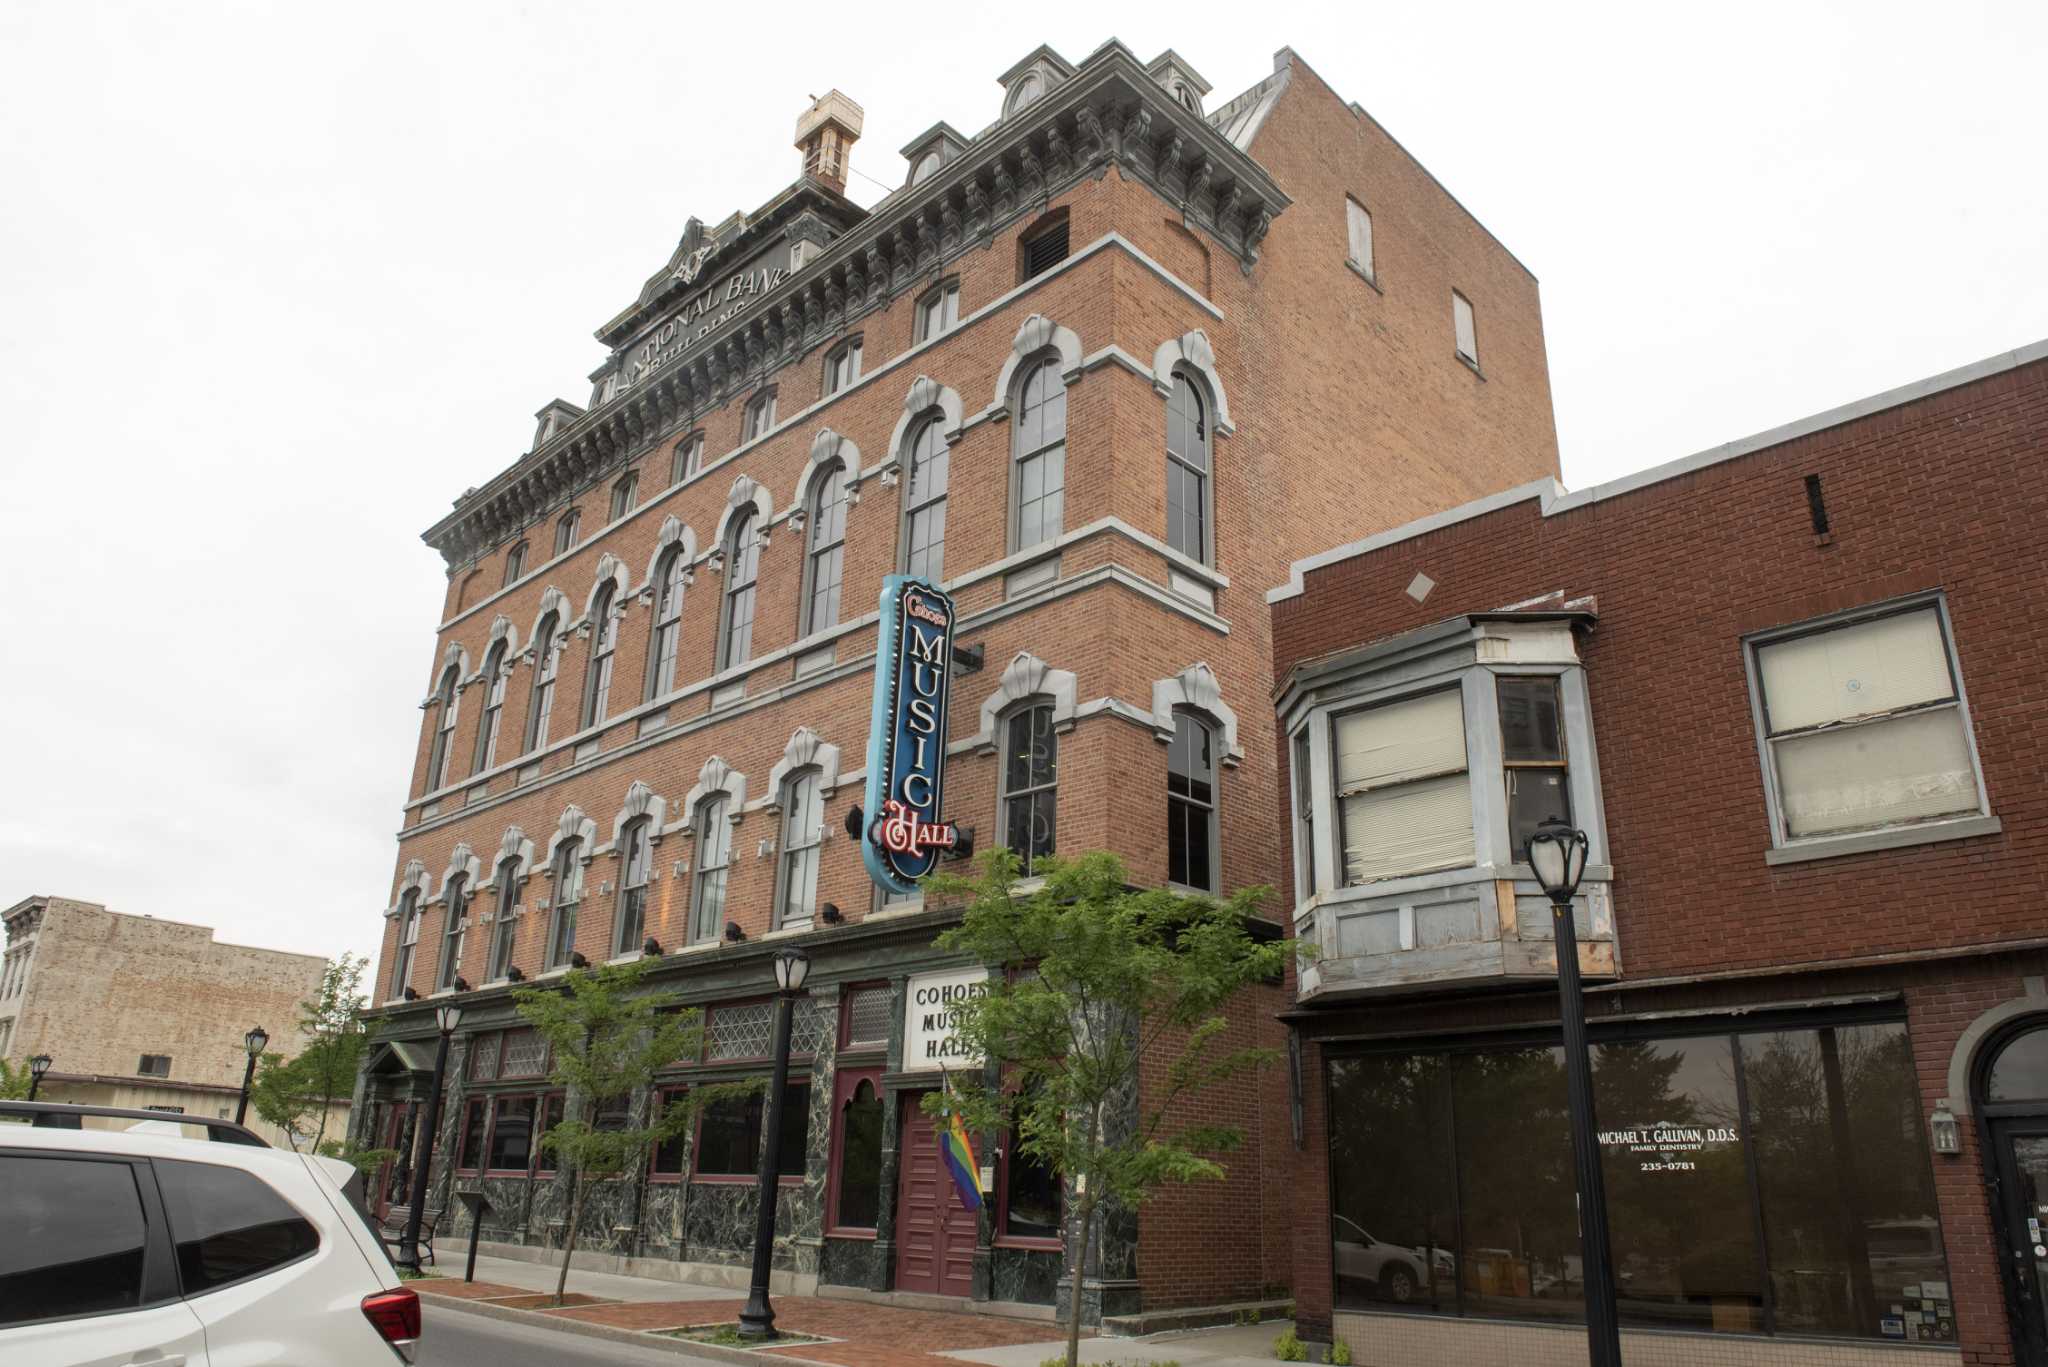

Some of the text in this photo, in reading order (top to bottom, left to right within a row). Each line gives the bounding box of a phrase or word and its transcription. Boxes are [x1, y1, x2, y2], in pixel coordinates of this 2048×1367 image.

[725, 268, 790, 301] BANK
[904, 625, 945, 807] MUSIC
[926, 1038, 972, 1057] HALL
[1597, 1128, 1739, 1145] MICHAEL T. GALLIVAN, D.D.S.
[1660, 1143, 1701, 1151] DENTISTRY
[1640, 1162, 1695, 1171] 235-0781
